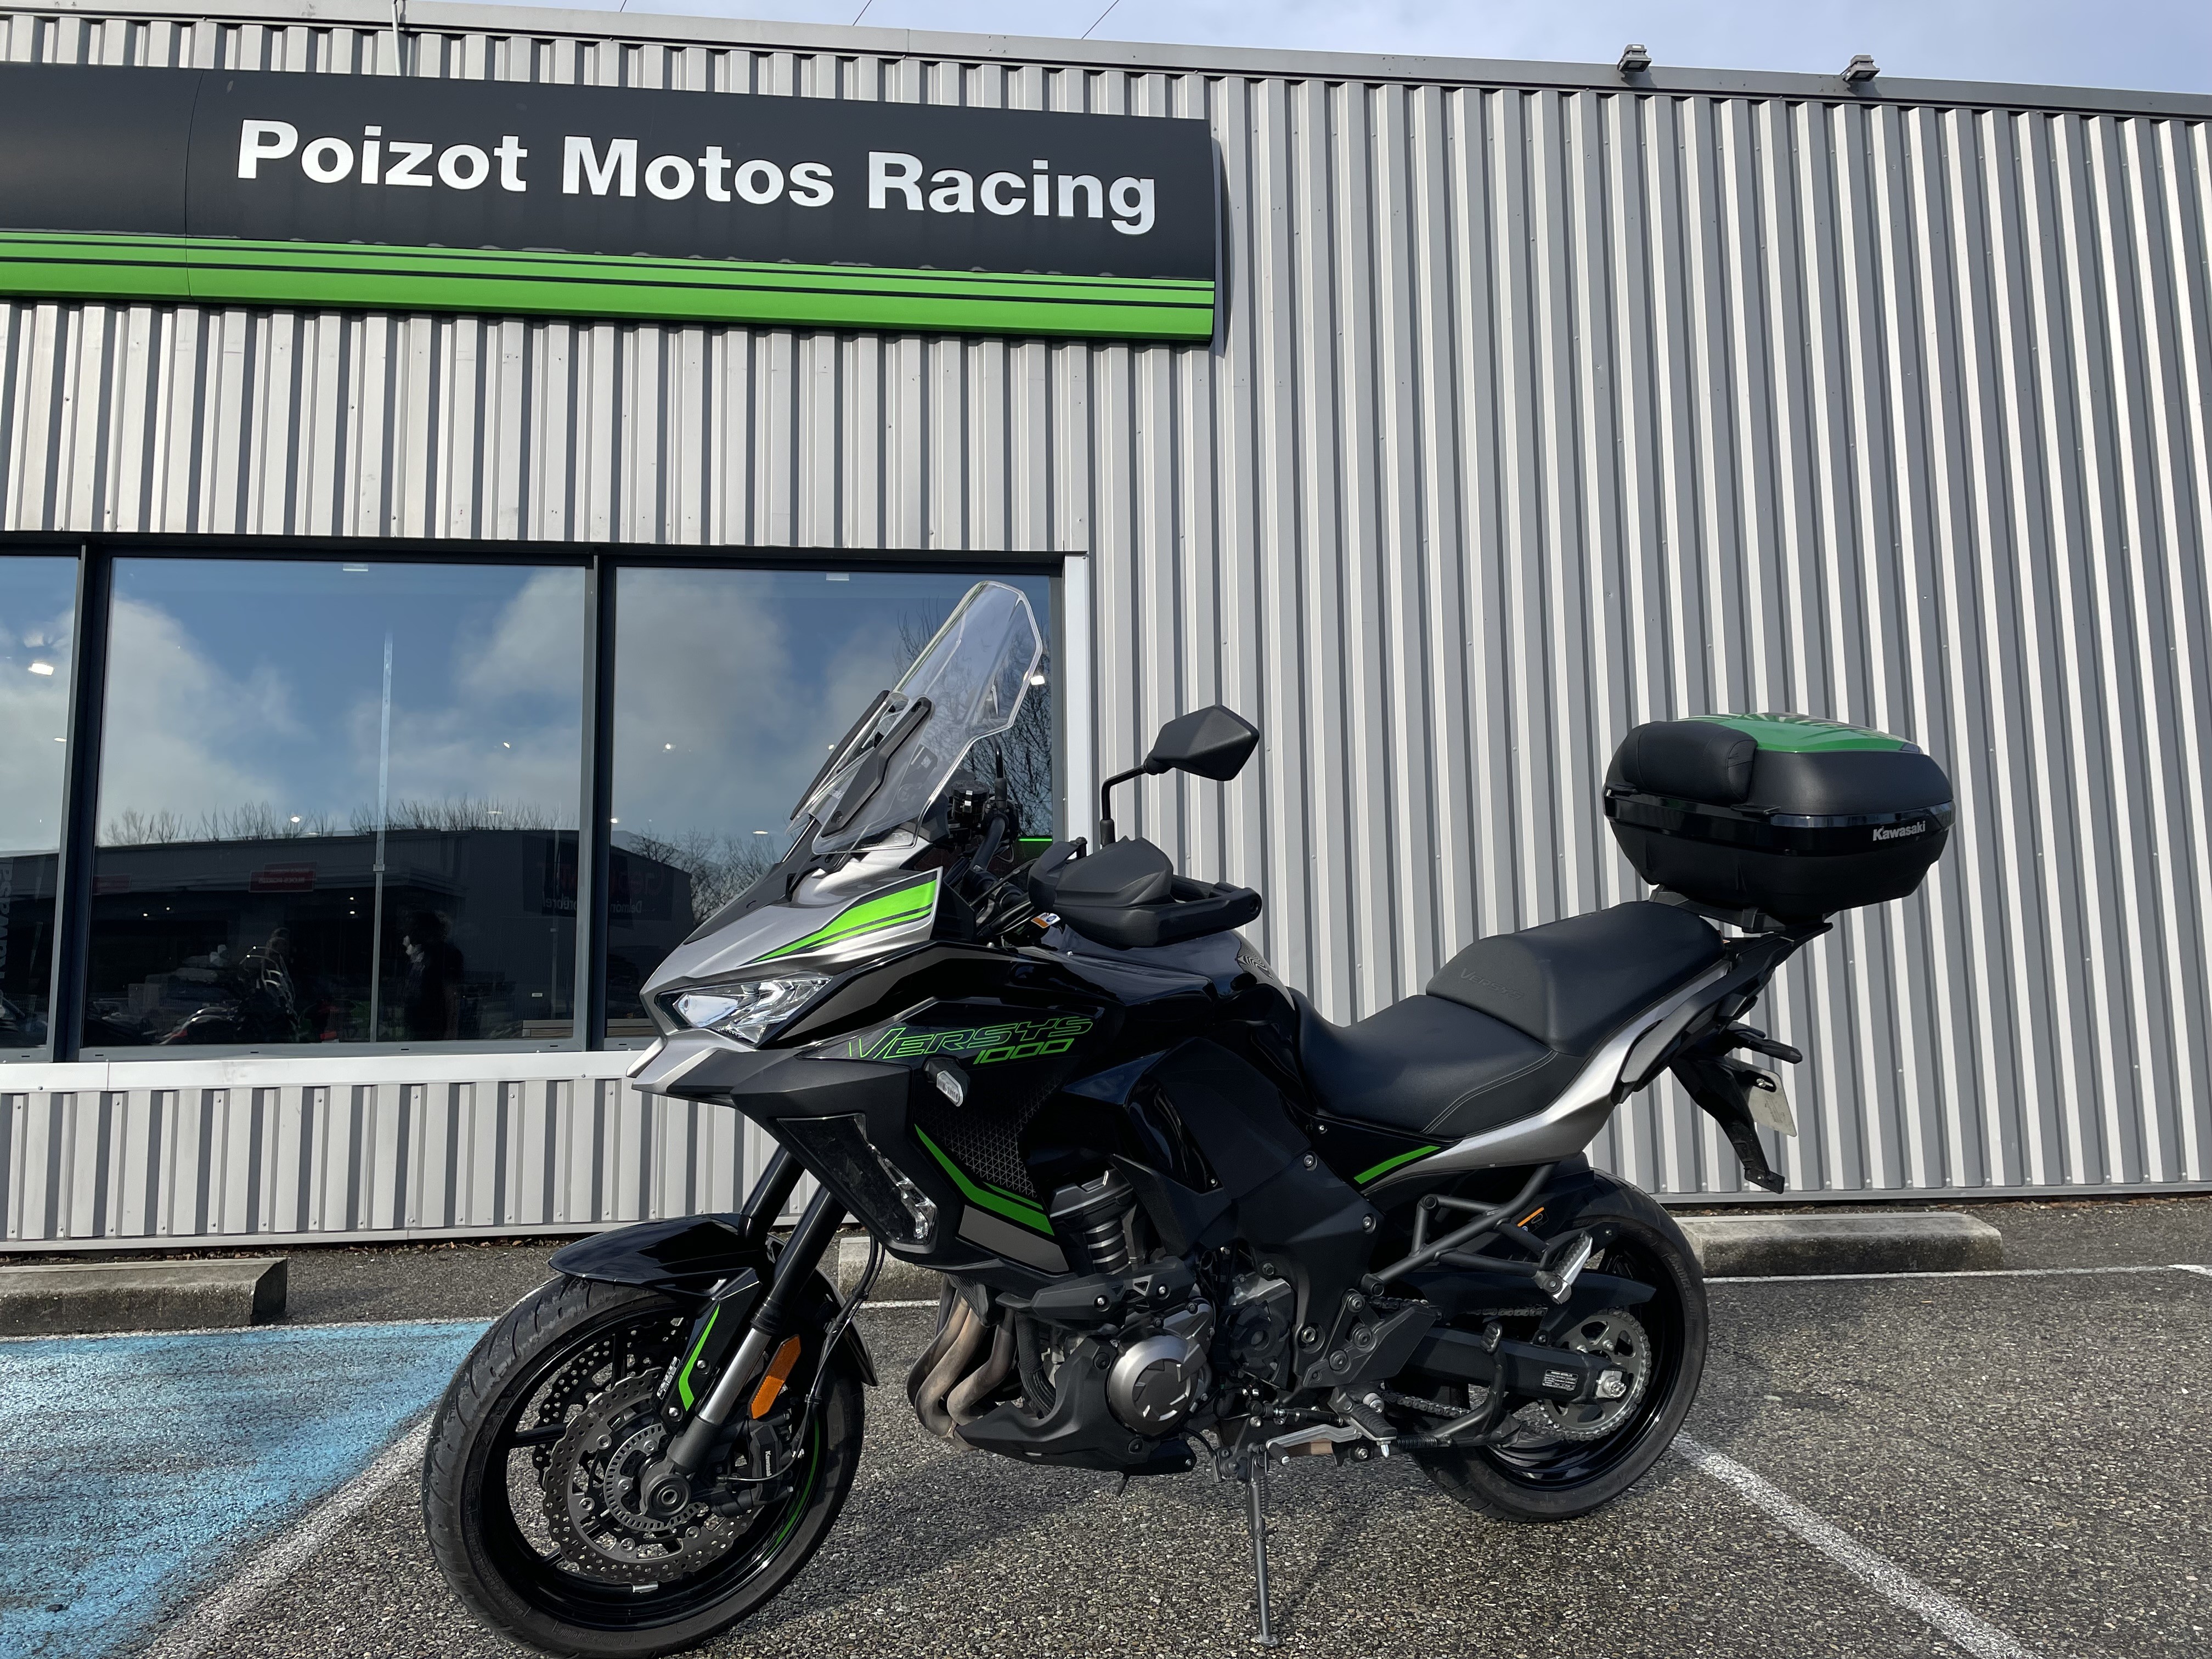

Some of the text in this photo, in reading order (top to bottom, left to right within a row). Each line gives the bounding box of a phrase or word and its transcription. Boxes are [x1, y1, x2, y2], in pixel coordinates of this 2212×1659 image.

[236, 119, 1156, 235] Poizot Motos Racing
[1872, 820, 1926, 842] Kawasaki
[849, 1016, 1093, 1059] VERSYS
[973, 1038, 1075, 1065] 1000
